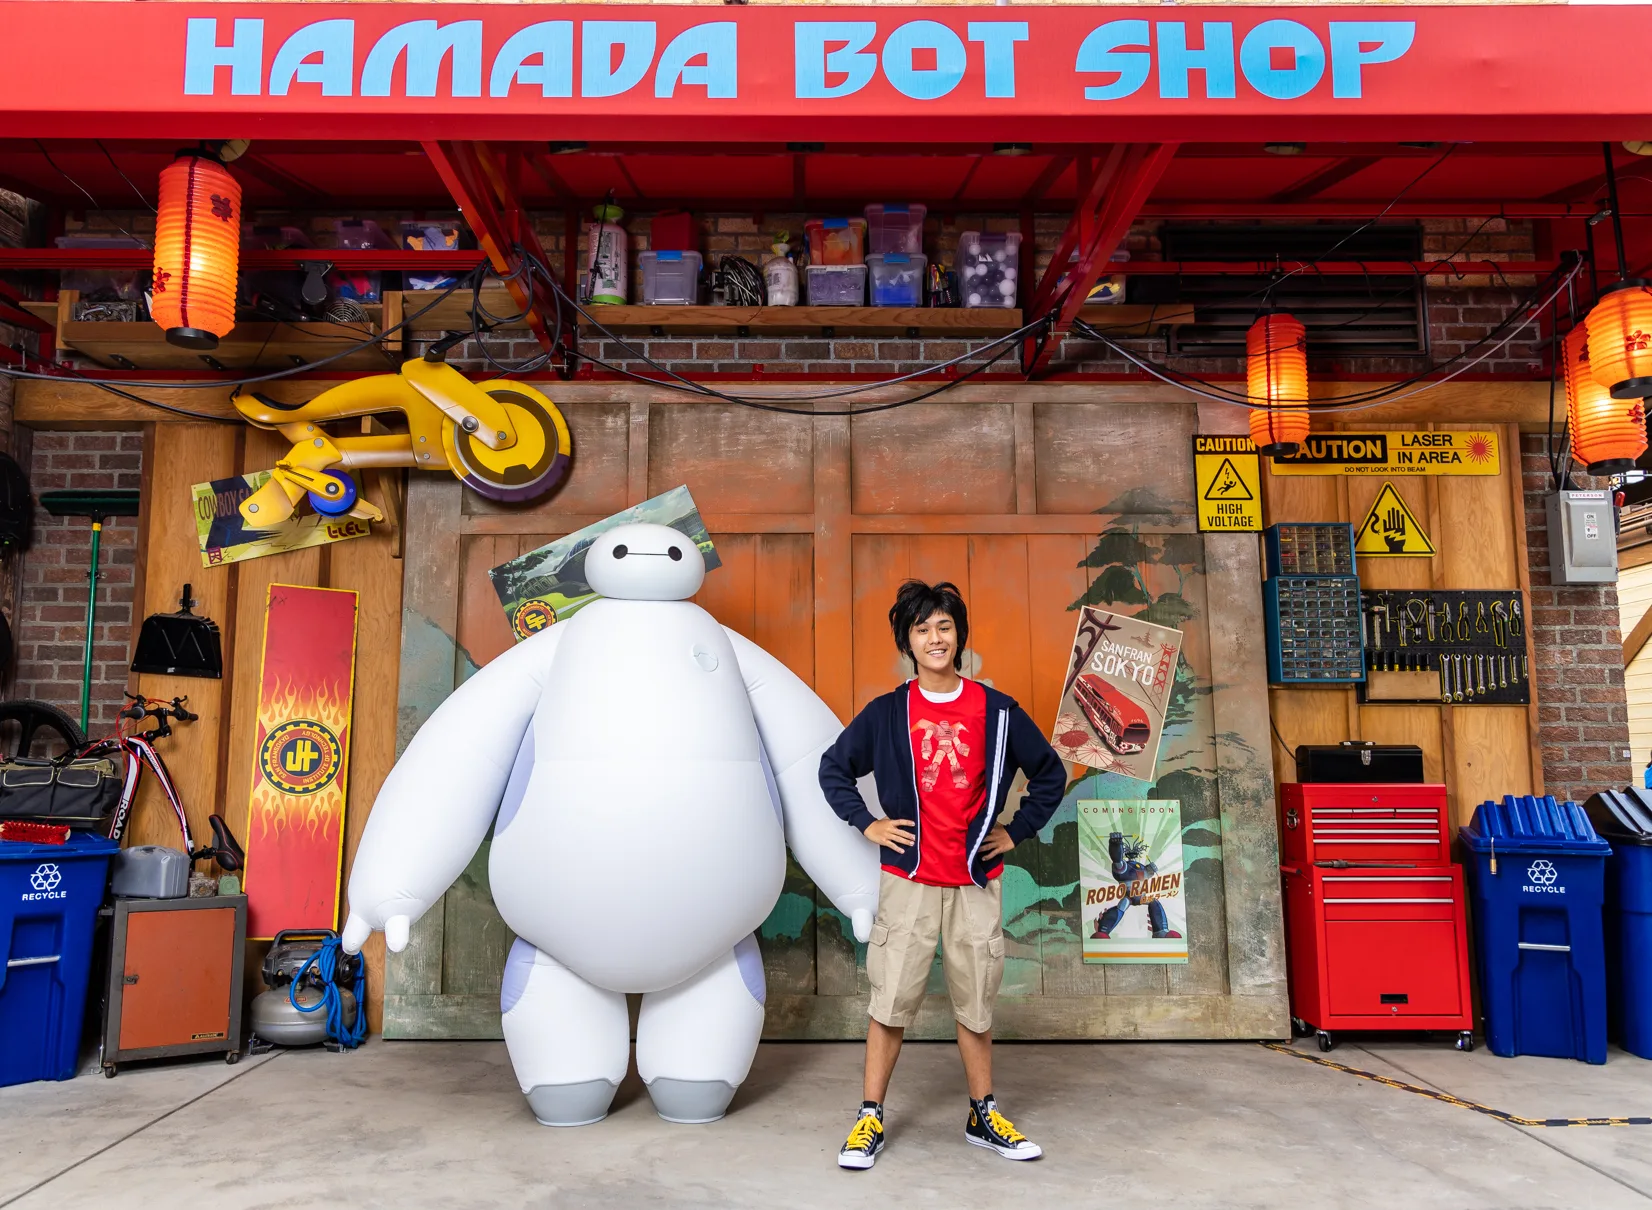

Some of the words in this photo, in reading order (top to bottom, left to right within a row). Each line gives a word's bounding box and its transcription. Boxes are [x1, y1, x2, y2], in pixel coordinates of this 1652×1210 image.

[185, 19, 736, 97] HAMADA
[796, 21, 1028, 99] BOT
[1076, 20, 1415, 100] SHOP
[1196, 438, 1256, 451] CAUTION
[1401, 434, 1453, 447] LASER
[1283, 440, 1383, 459] AUTION
[1397, 452, 1413, 464] IN
[1418, 452, 1462, 464] AREA
[198, 490, 236, 521] COWBOY
[1217, 503, 1243, 514] HIGH
[1207, 515, 1254, 527] VOLTAGE
[1091, 651, 1155, 686] SOKYO
[113, 799, 129, 840] ROAD
[1086, 885, 1127, 905] ROBO
[1130, 872, 1181, 898] RAMEN
[1522, 885, 1566, 894] RECYCLE
[22, 890, 67, 901] RECYCLE
